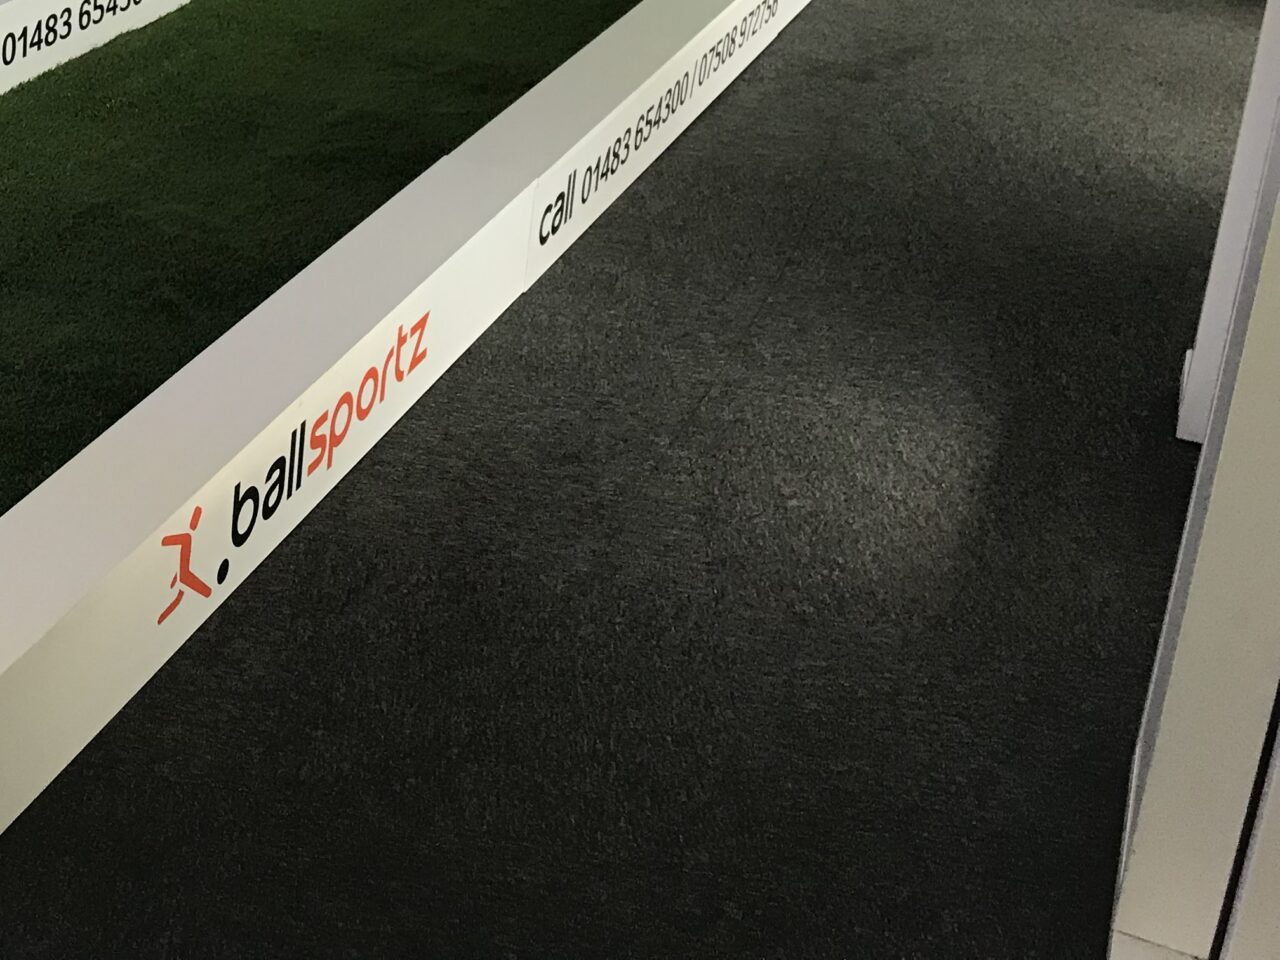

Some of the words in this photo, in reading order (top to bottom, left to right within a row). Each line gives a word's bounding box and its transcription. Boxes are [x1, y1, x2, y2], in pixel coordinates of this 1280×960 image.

[1, 8, 73, 67] 01483
[538, 168, 578, 246] call
[581, 126, 632, 204] 01483
[634, 71, 689, 151] 654300
[698, 25, 739, 87] 07508
[231, 310, 431, 548] ballsportz
